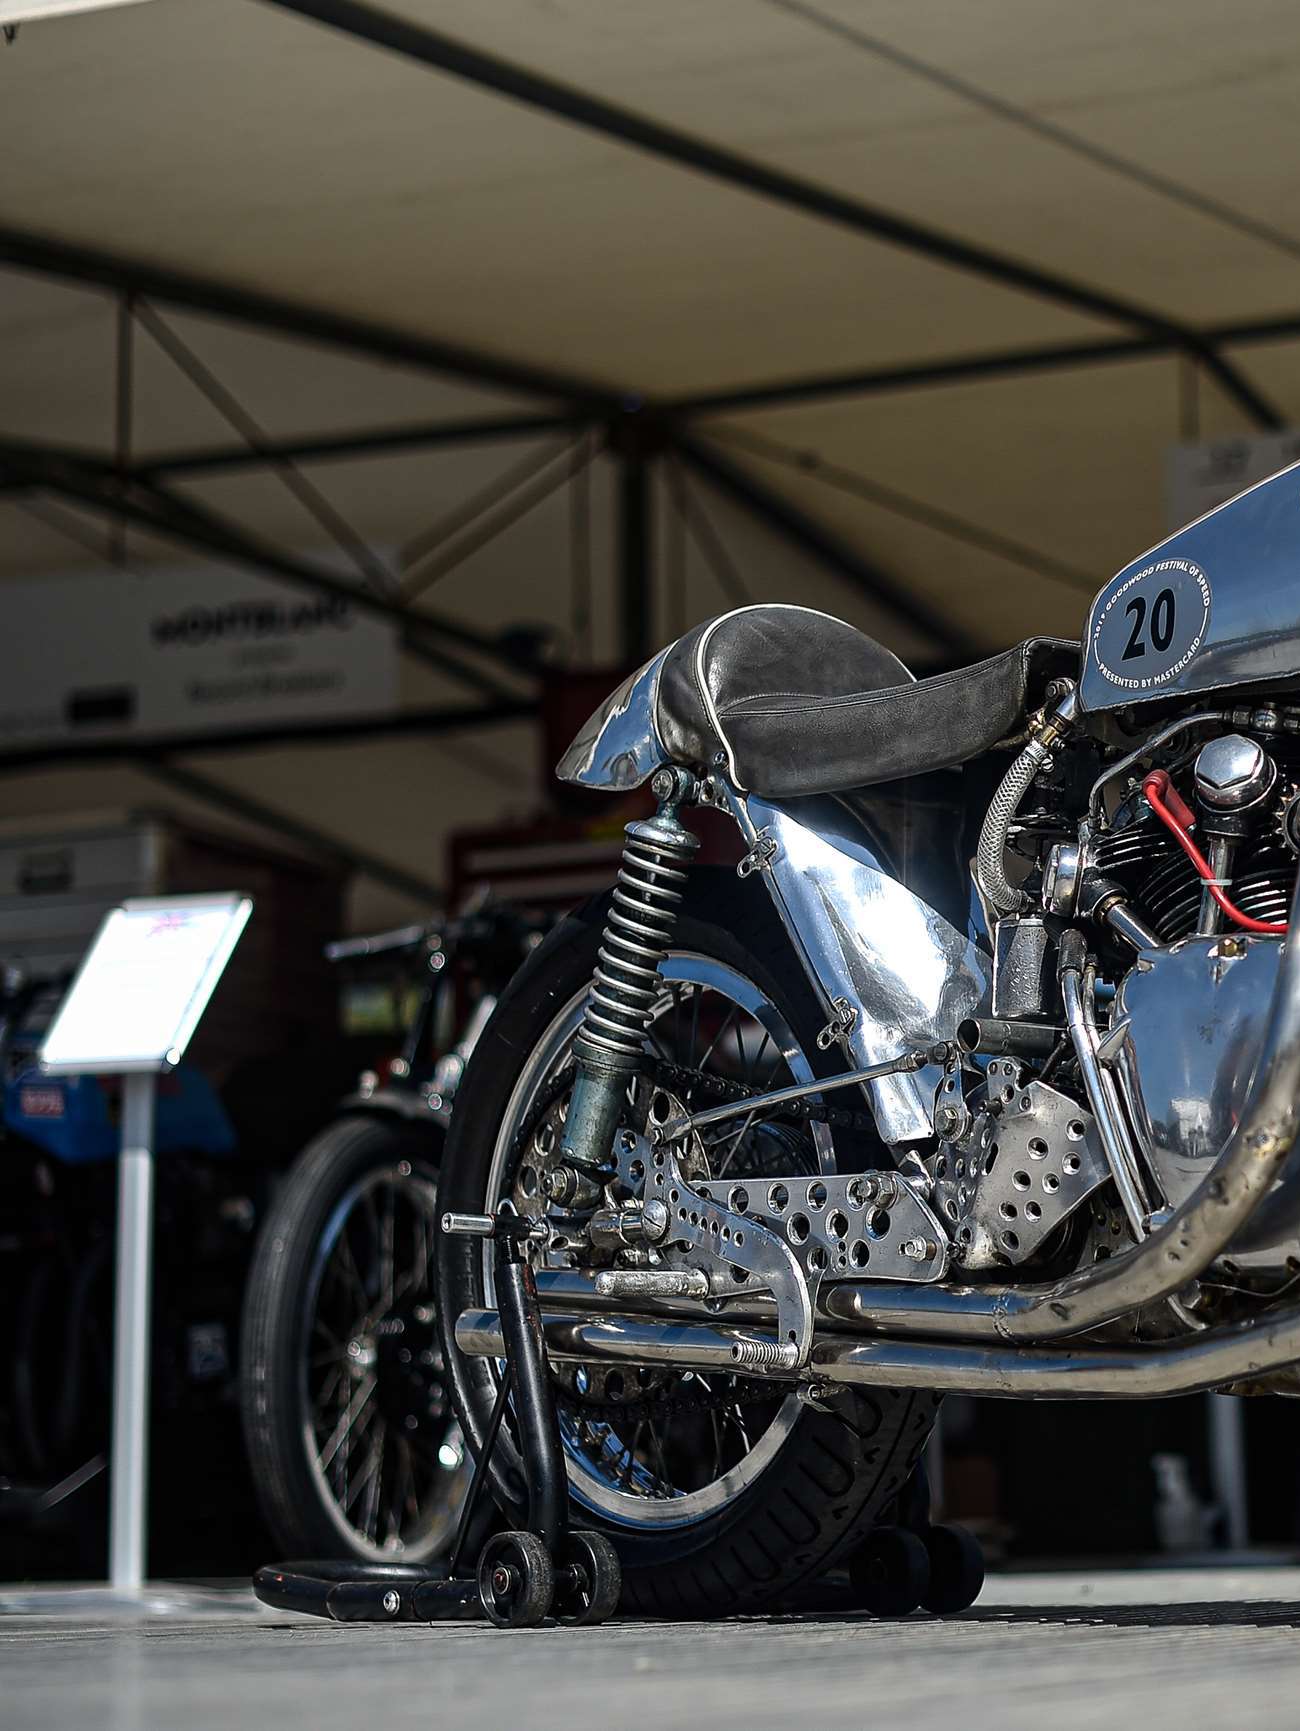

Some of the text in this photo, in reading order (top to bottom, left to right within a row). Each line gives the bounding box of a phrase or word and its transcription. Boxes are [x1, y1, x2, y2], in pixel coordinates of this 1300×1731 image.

[1105, 566, 1154, 611] GOODWOOD
[1155, 560, 1189, 572] FESTIVAL
[1189, 565, 1200, 577] OF
[1196, 574, 1211, 607] SPEED
[1121, 588, 1175, 661] 20
[1099, 637, 1201, 689] PRESENTED BY MASTERCARD
